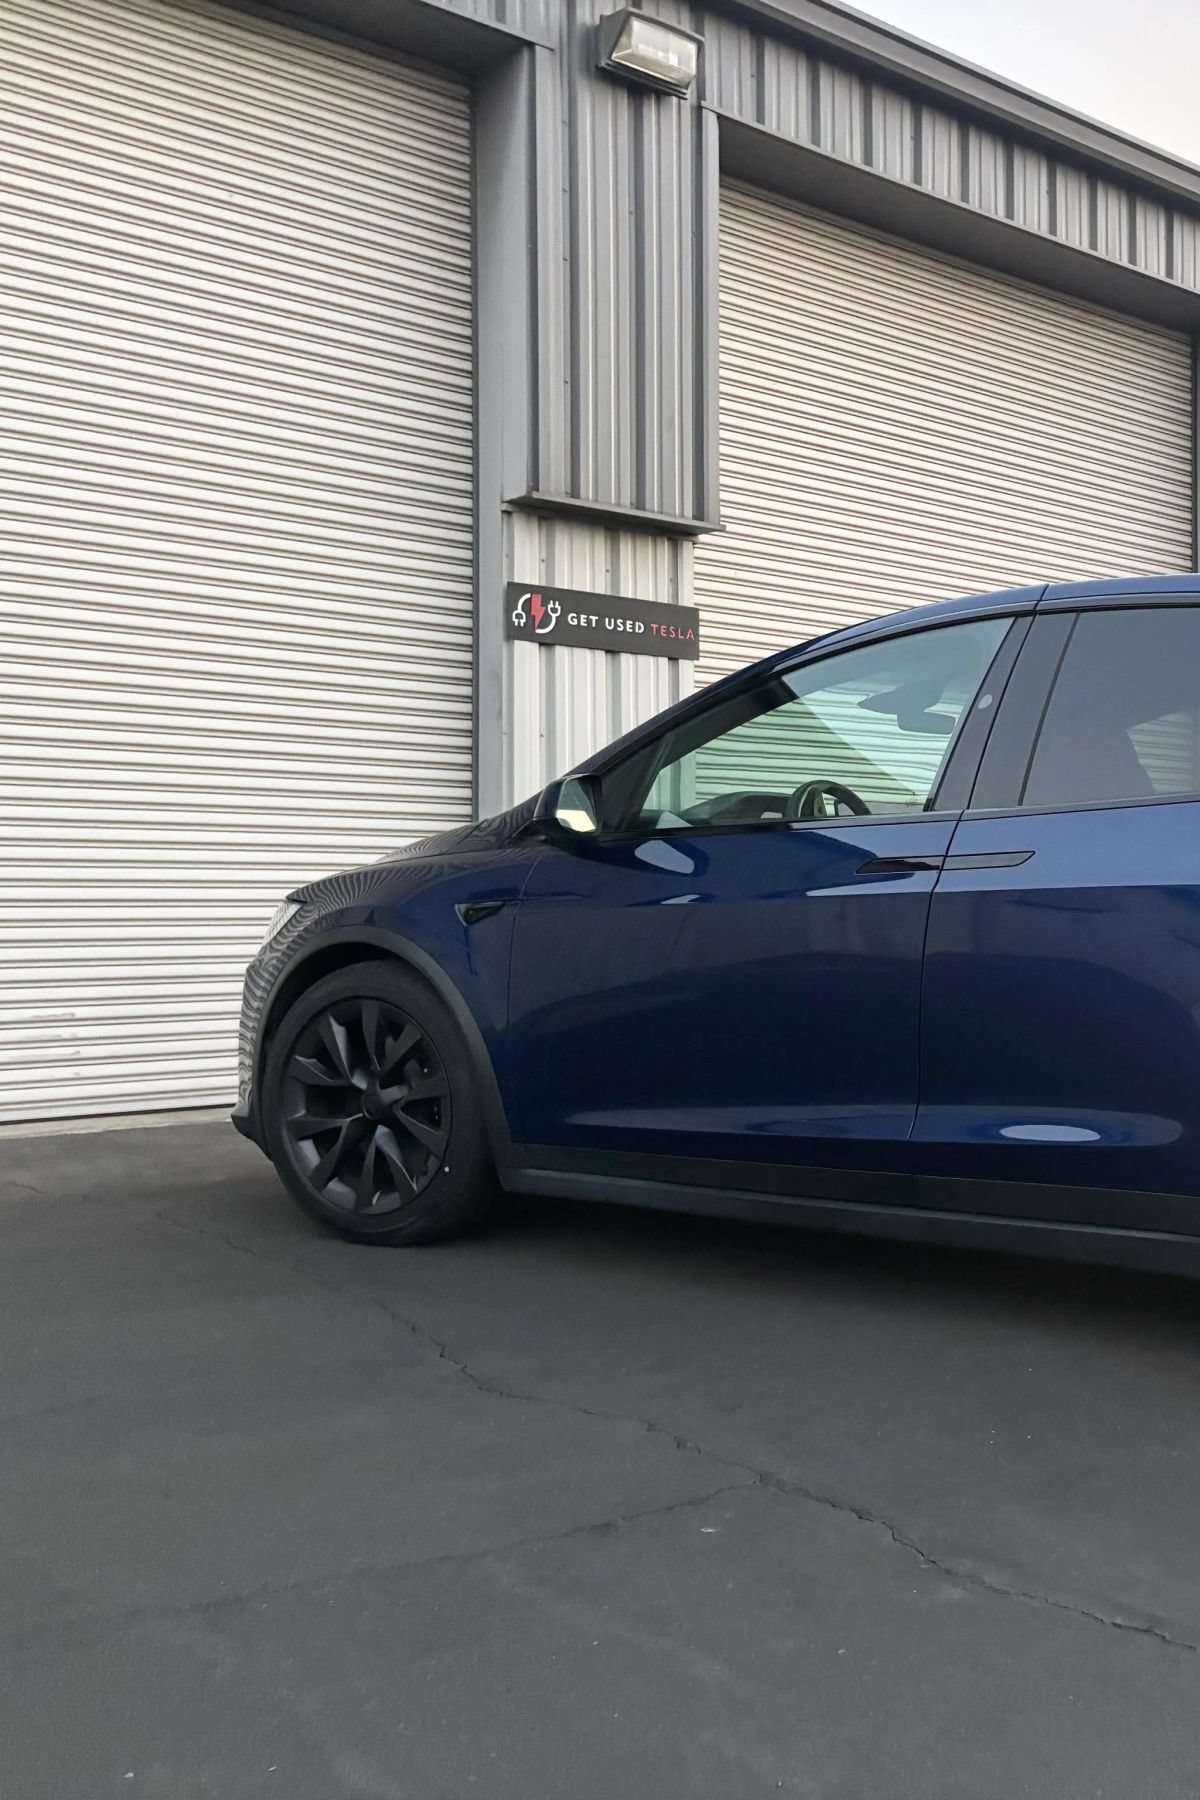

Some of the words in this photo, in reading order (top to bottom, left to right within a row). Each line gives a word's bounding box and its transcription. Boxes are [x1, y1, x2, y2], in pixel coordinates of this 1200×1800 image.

[568, 612, 599, 628] GET
[605, 617, 645, 634] USED
[650, 623, 695, 641] TESLA
